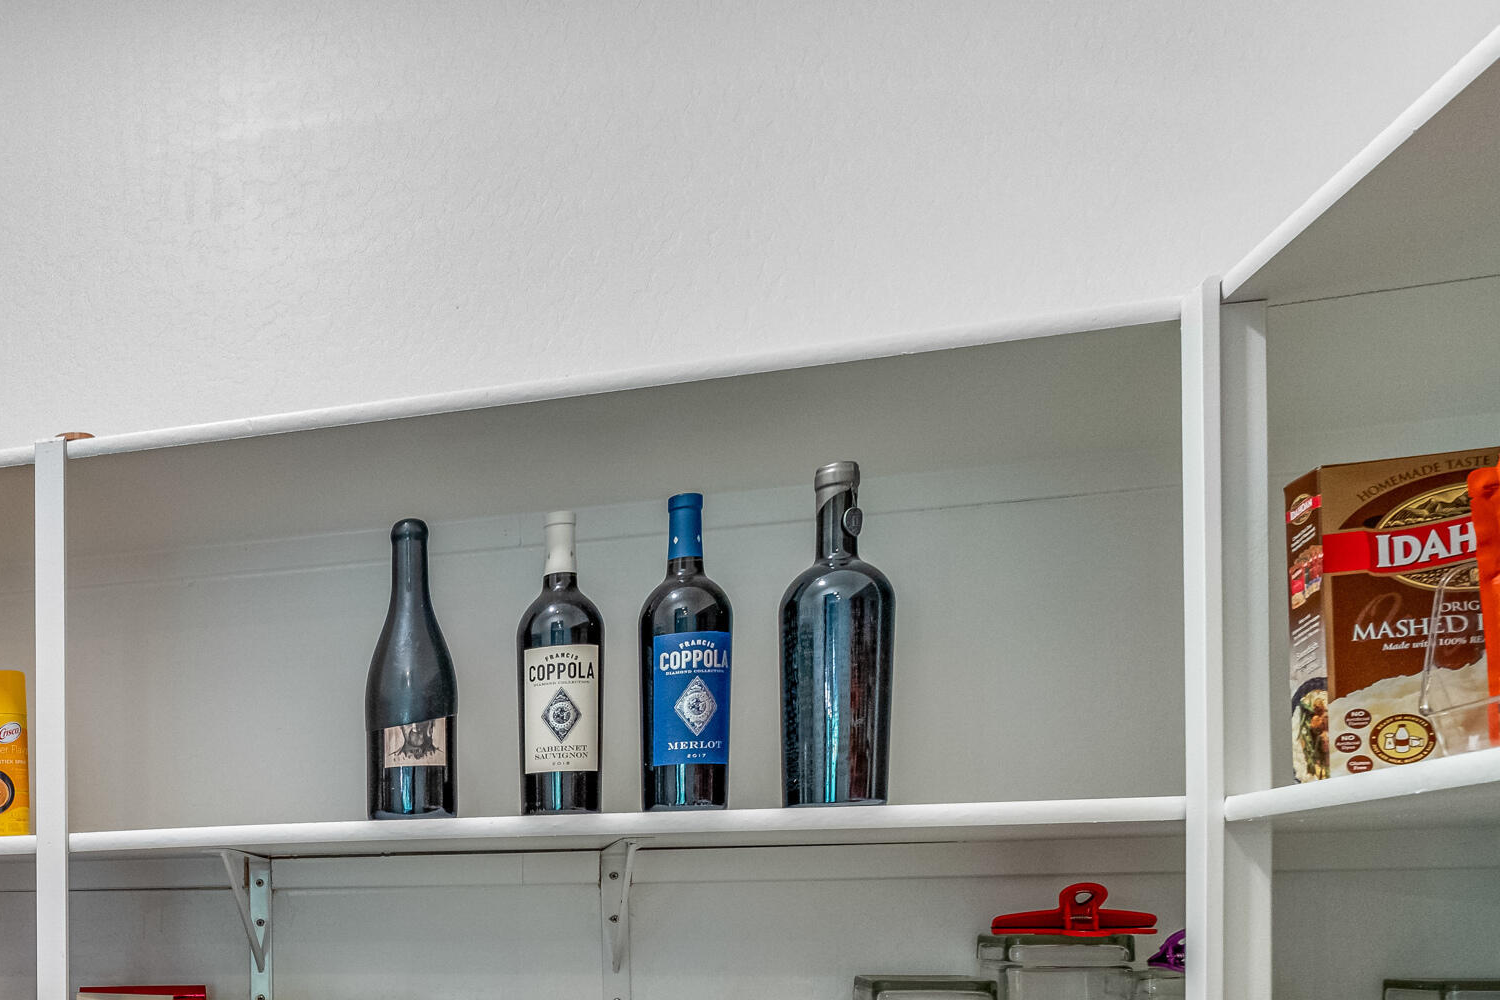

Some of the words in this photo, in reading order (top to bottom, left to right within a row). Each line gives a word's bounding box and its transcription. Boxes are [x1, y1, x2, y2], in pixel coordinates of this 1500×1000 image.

[1357, 462, 1441, 502] HOMEMADE
[1445, 455, 1491, 470] TASTE
[1375, 521, 1478, 568] IDAH
[1351, 614, 1469, 641] MASHED
[679, 639, 715, 650] FRANCIS
[1382, 641, 1410, 651] Made
[1412, 639, 1431, 649] wit
[1439, 636, 1467, 646] 100%
[545, 652, 579, 662] FRANCIS
[659, 649, 729, 671] COPPOLA
[529, 661, 595, 682] COPPOLA
[536, 745, 588, 753] CABERNET
[668, 741, 722, 751] MERLOT
[535, 752, 588, 761] SAUVIGNON
